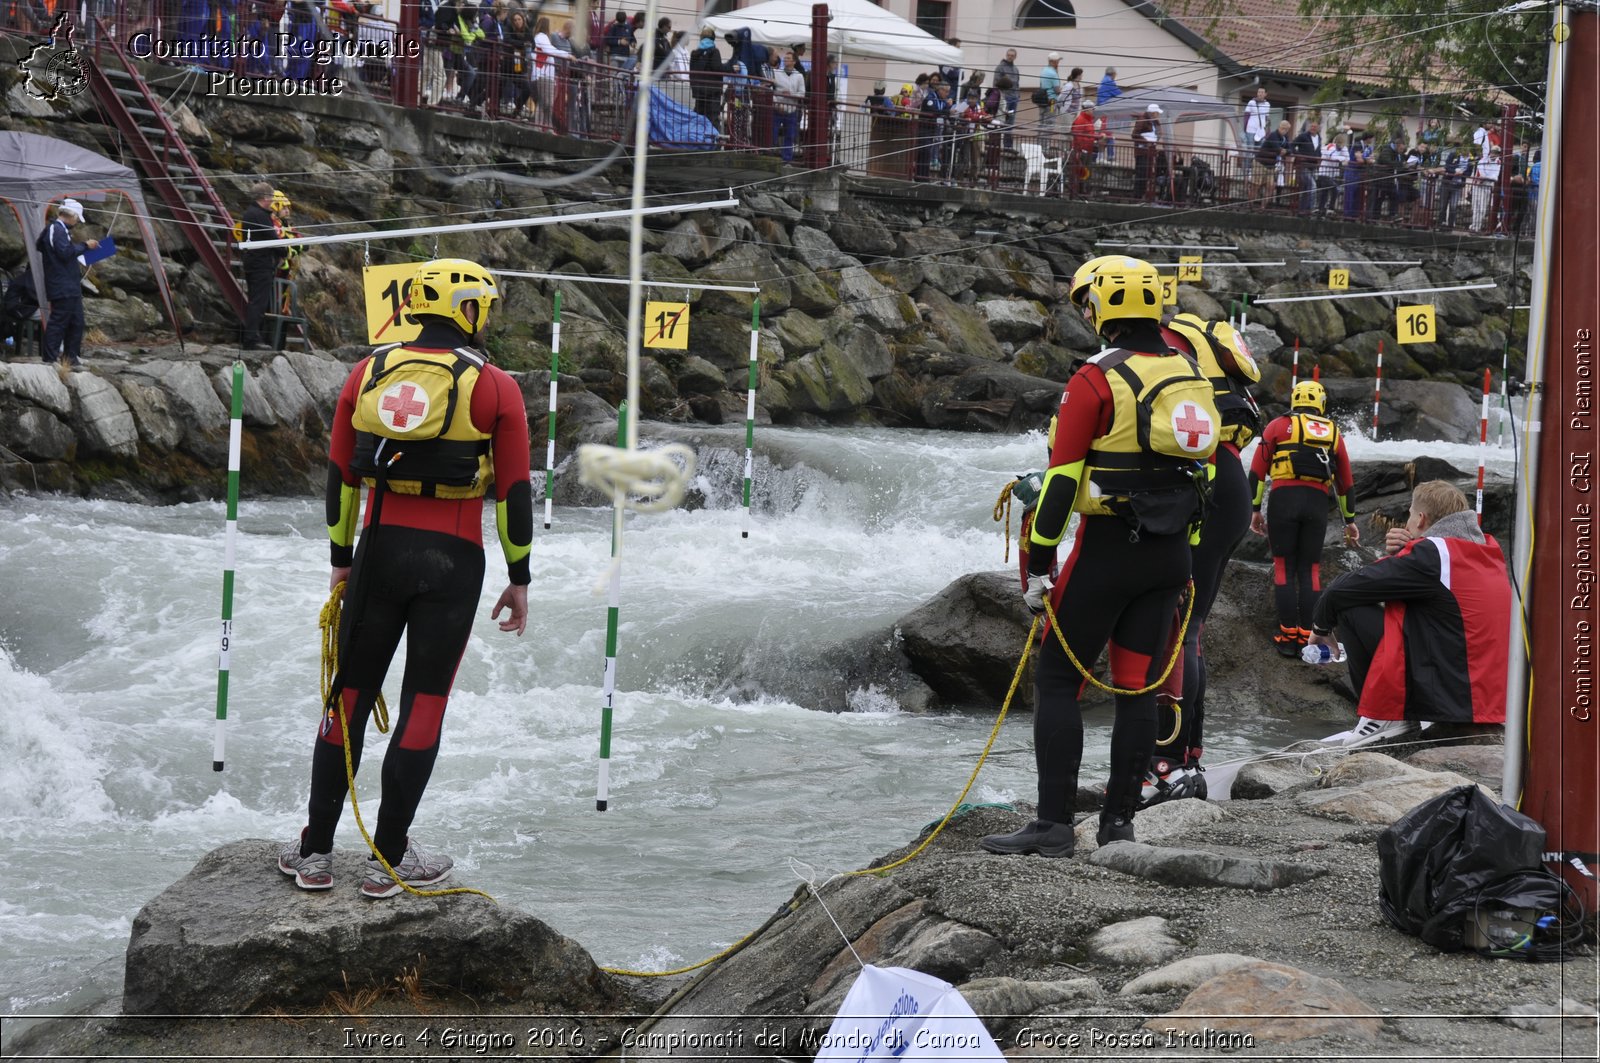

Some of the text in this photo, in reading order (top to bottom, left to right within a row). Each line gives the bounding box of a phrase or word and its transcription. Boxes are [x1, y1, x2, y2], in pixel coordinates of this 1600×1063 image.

[1184, 261, 1198, 276] 14
[1333, 273, 1346, 286] 12
[1163, 281, 1172, 299] 5
[655, 310, 682, 339] 17
[1405, 313, 1429, 336] 16
[221, 637, 229, 652] 9
[606, 692, 613, 707] 1
